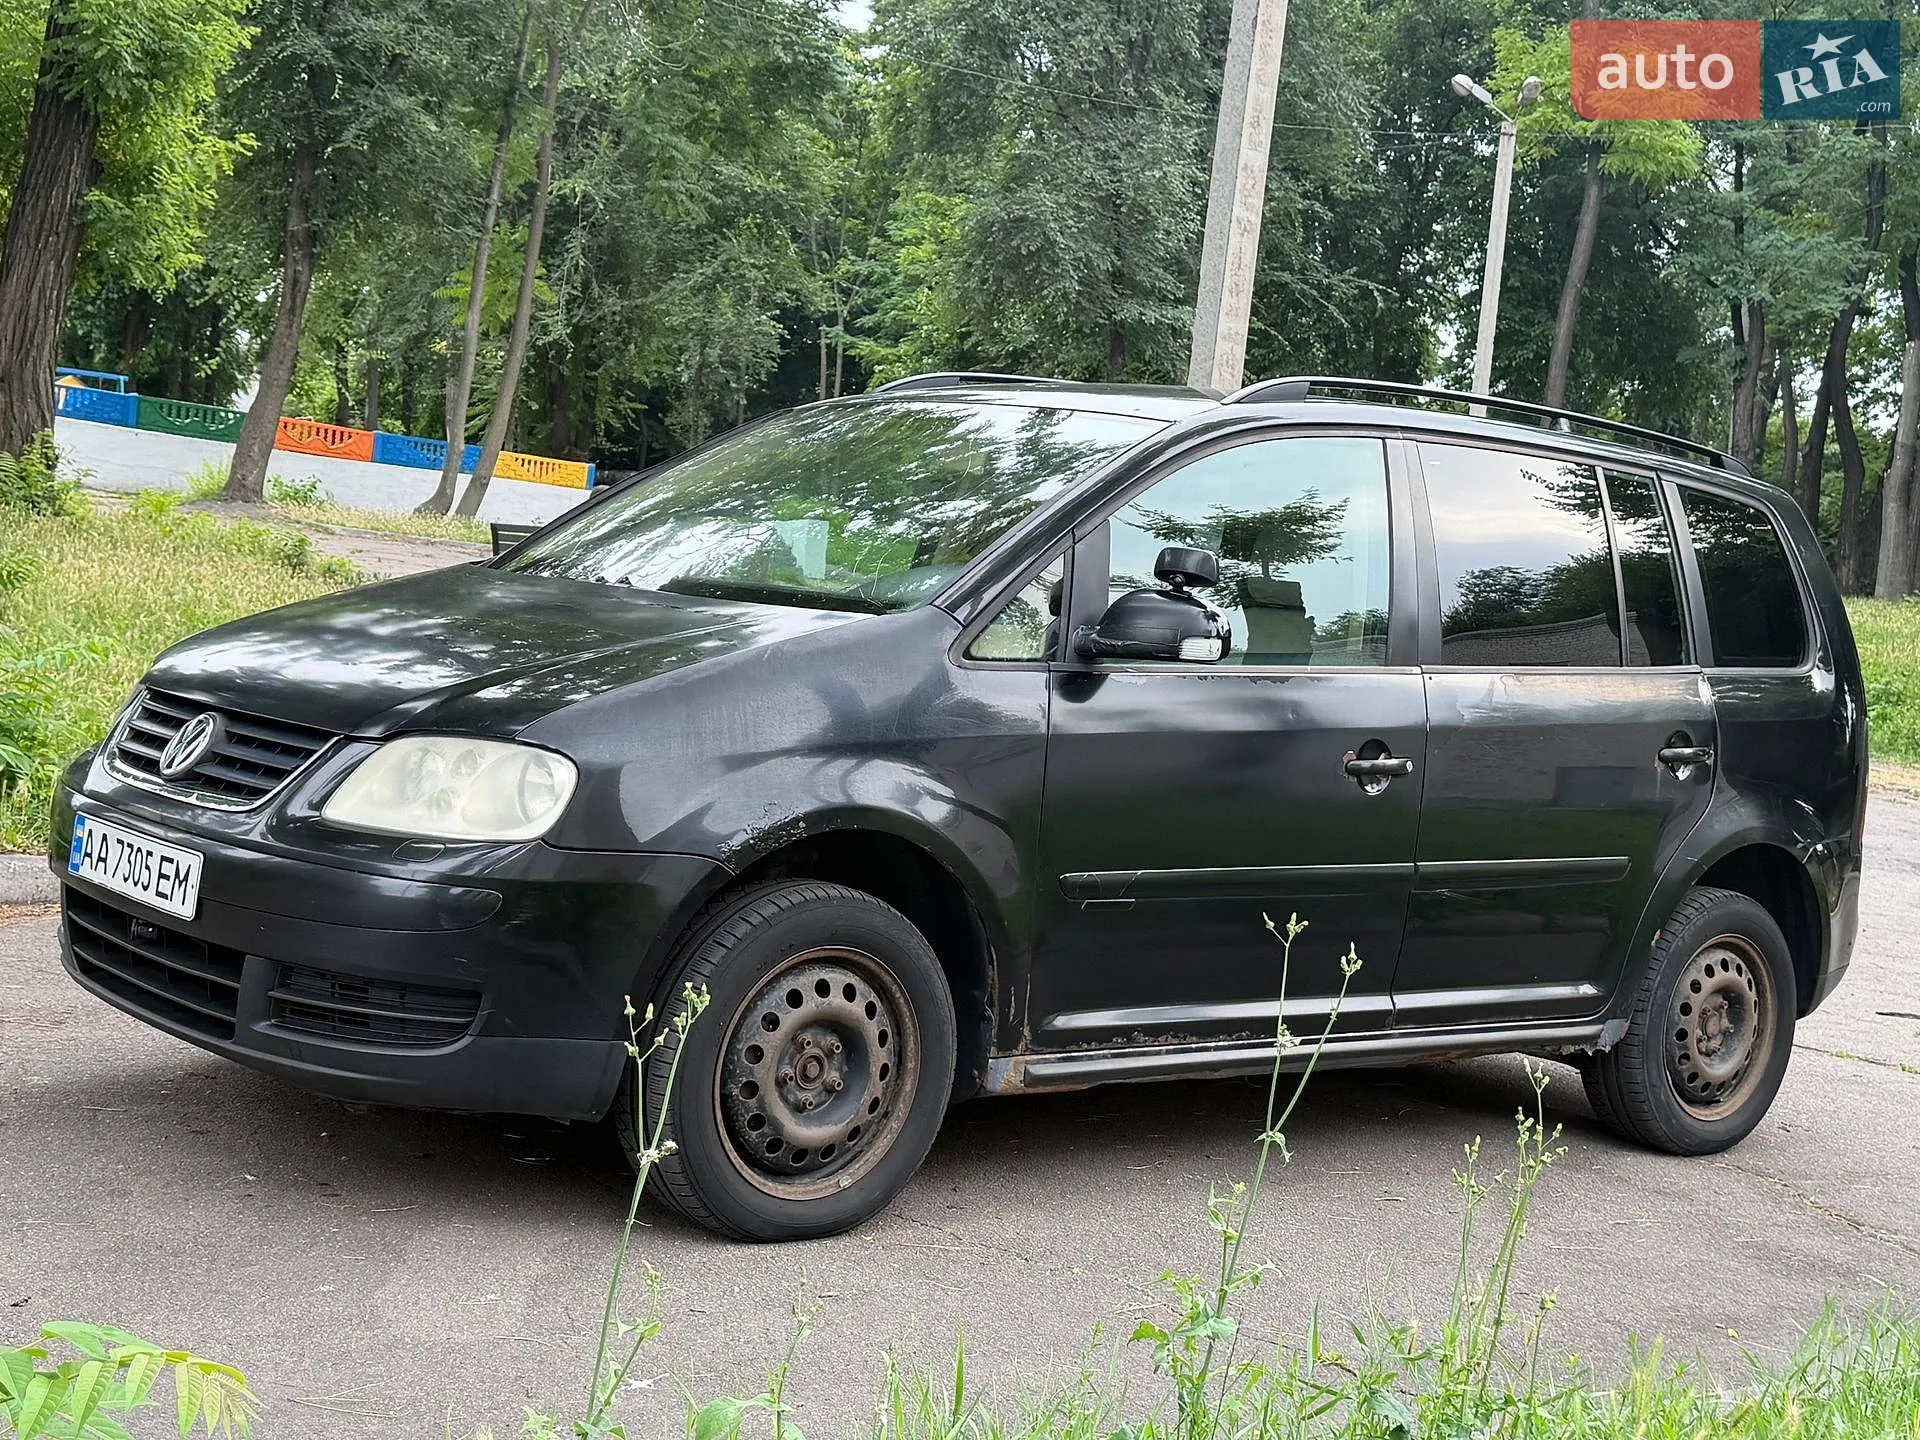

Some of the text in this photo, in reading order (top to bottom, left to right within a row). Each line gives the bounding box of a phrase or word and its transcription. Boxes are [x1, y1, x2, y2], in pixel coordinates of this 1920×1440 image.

[80, 828, 192, 907] AA 7305 EM
